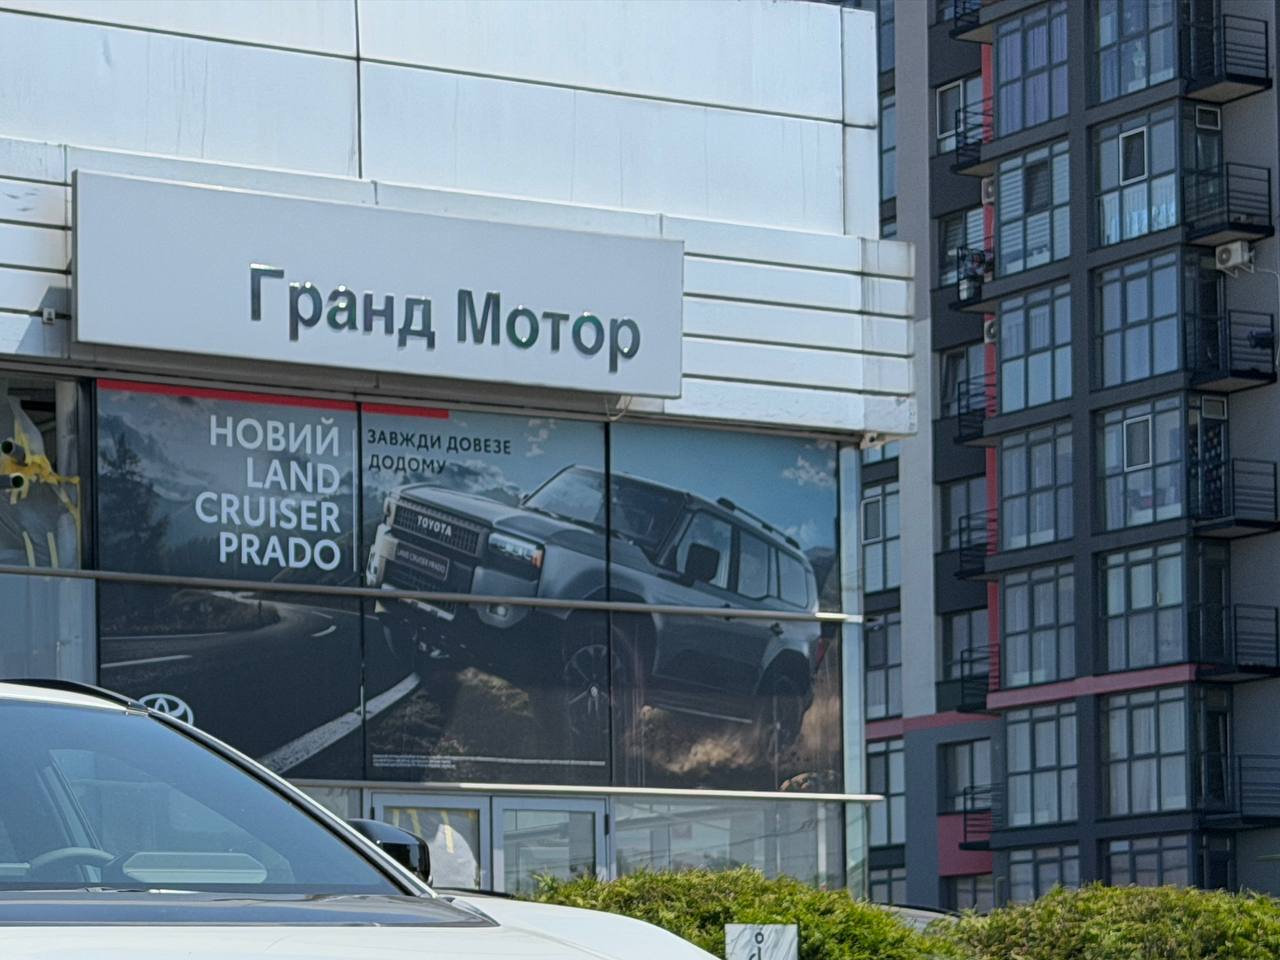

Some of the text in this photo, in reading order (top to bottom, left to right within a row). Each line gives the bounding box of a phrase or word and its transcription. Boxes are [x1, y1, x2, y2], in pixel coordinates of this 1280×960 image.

[250, 263, 642, 373] Гранд Мотор
[209, 414, 340, 458] НОВИЙ
[367, 429, 511, 455] ЗАВЖДИ ДОВЕЗЕ
[246, 457, 341, 495] LAND
[368, 454, 447, 476] ДОДОМУ
[195, 490, 341, 534] CRUISER
[417, 515, 452, 536] TOYOTA
[219, 531, 341, 572] PRADO
